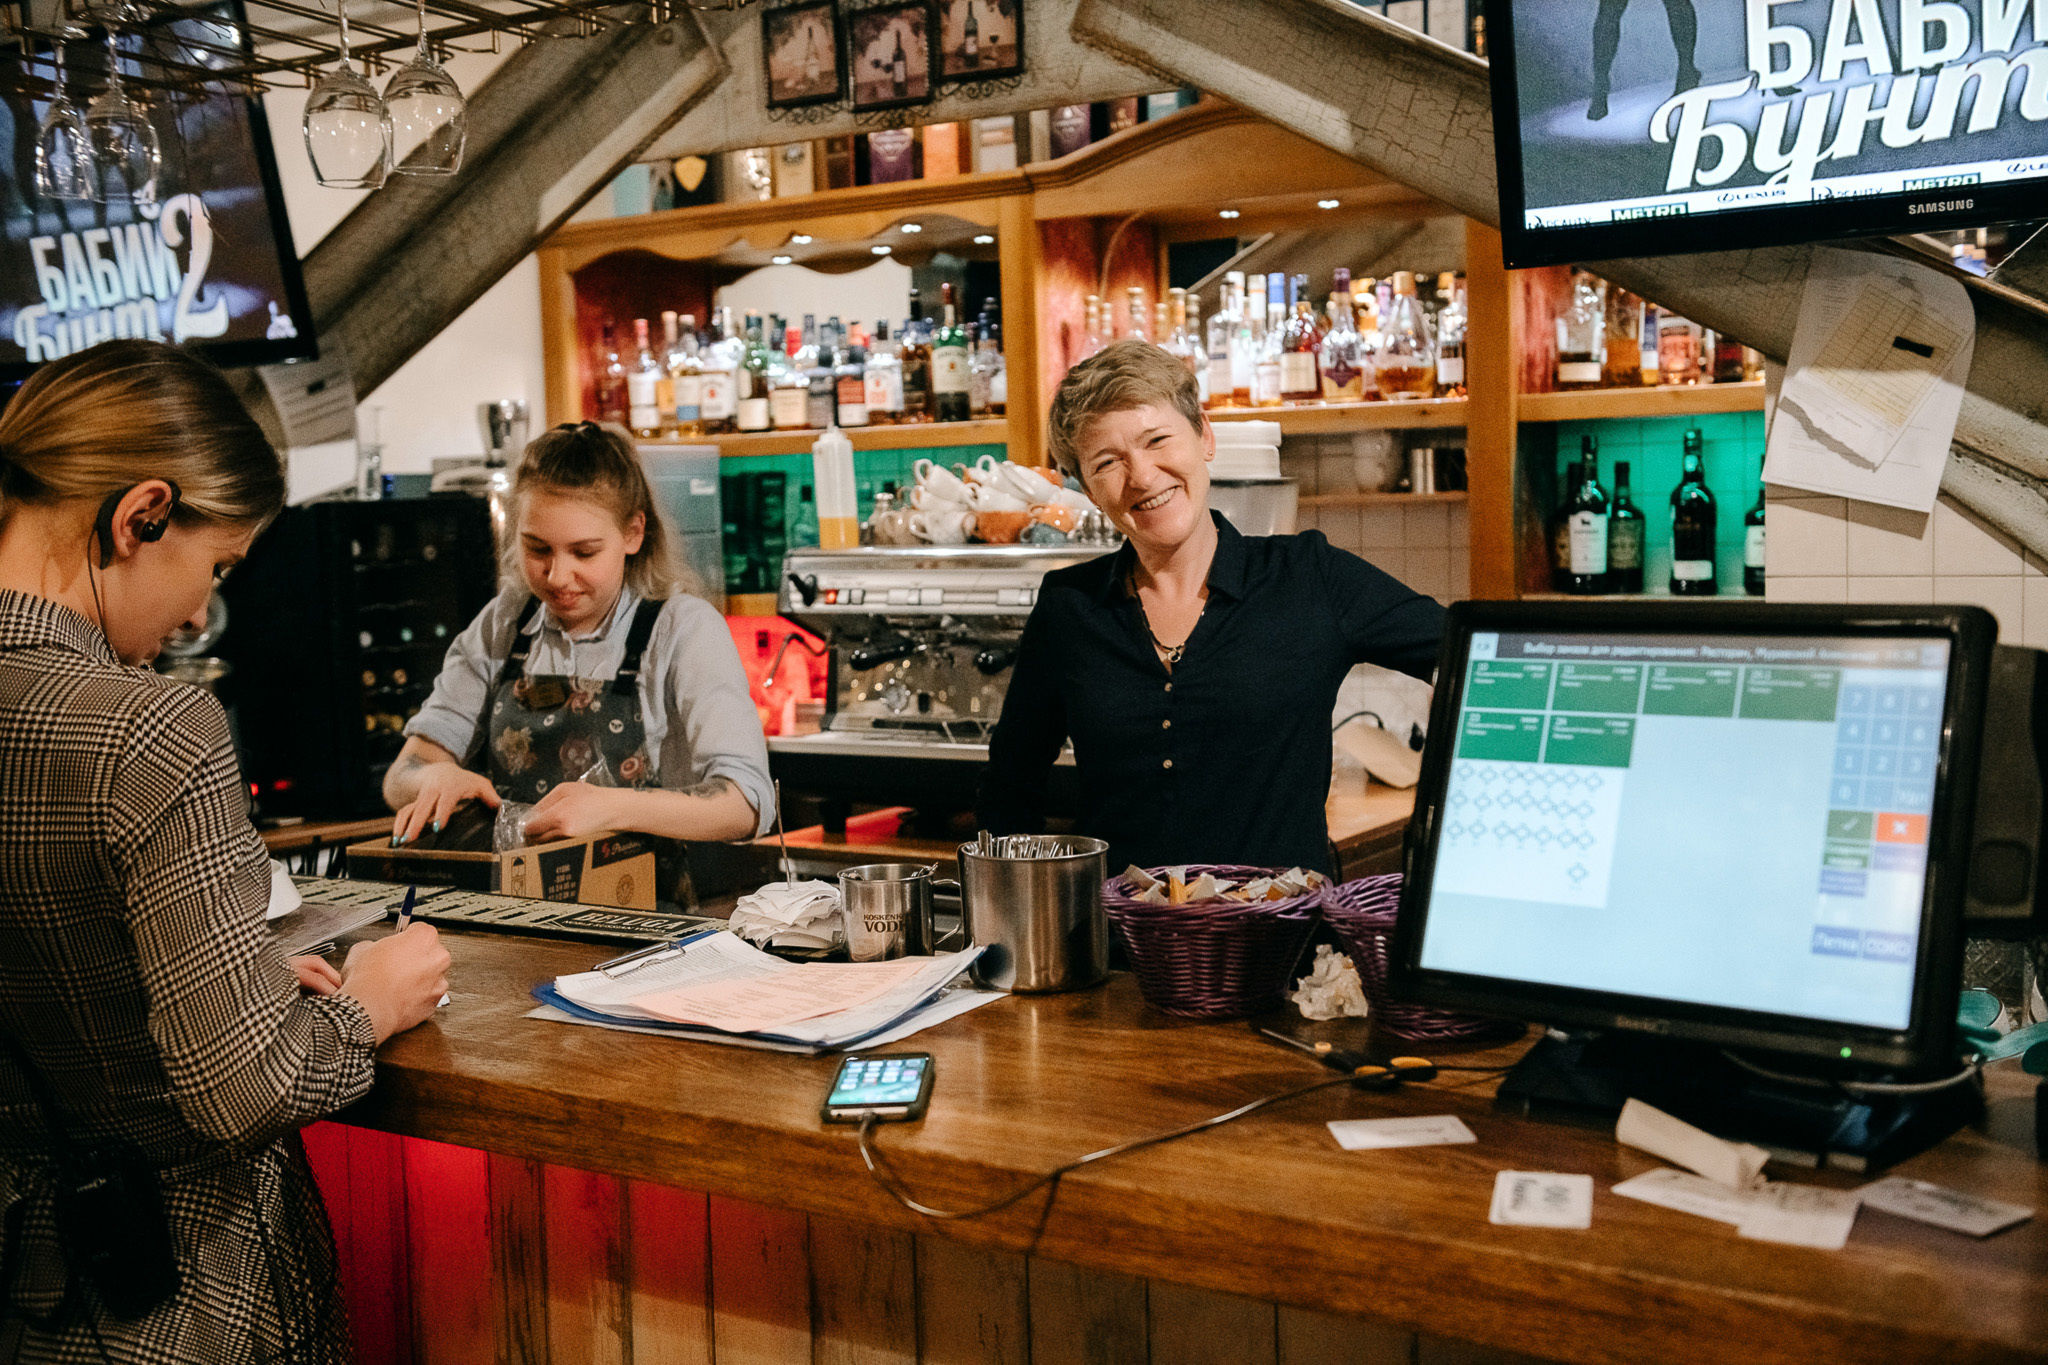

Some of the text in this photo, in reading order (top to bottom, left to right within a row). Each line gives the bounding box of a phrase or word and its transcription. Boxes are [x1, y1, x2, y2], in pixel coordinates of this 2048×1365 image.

[1904, 174, 1978, 191] METRO
[1613, 203, 1687, 222] METRO
[1908, 198, 1975, 215] SAMSUNG
[29, 193, 229, 345] БАБИЙ 2
[571, 912, 687, 931] BELUGA
